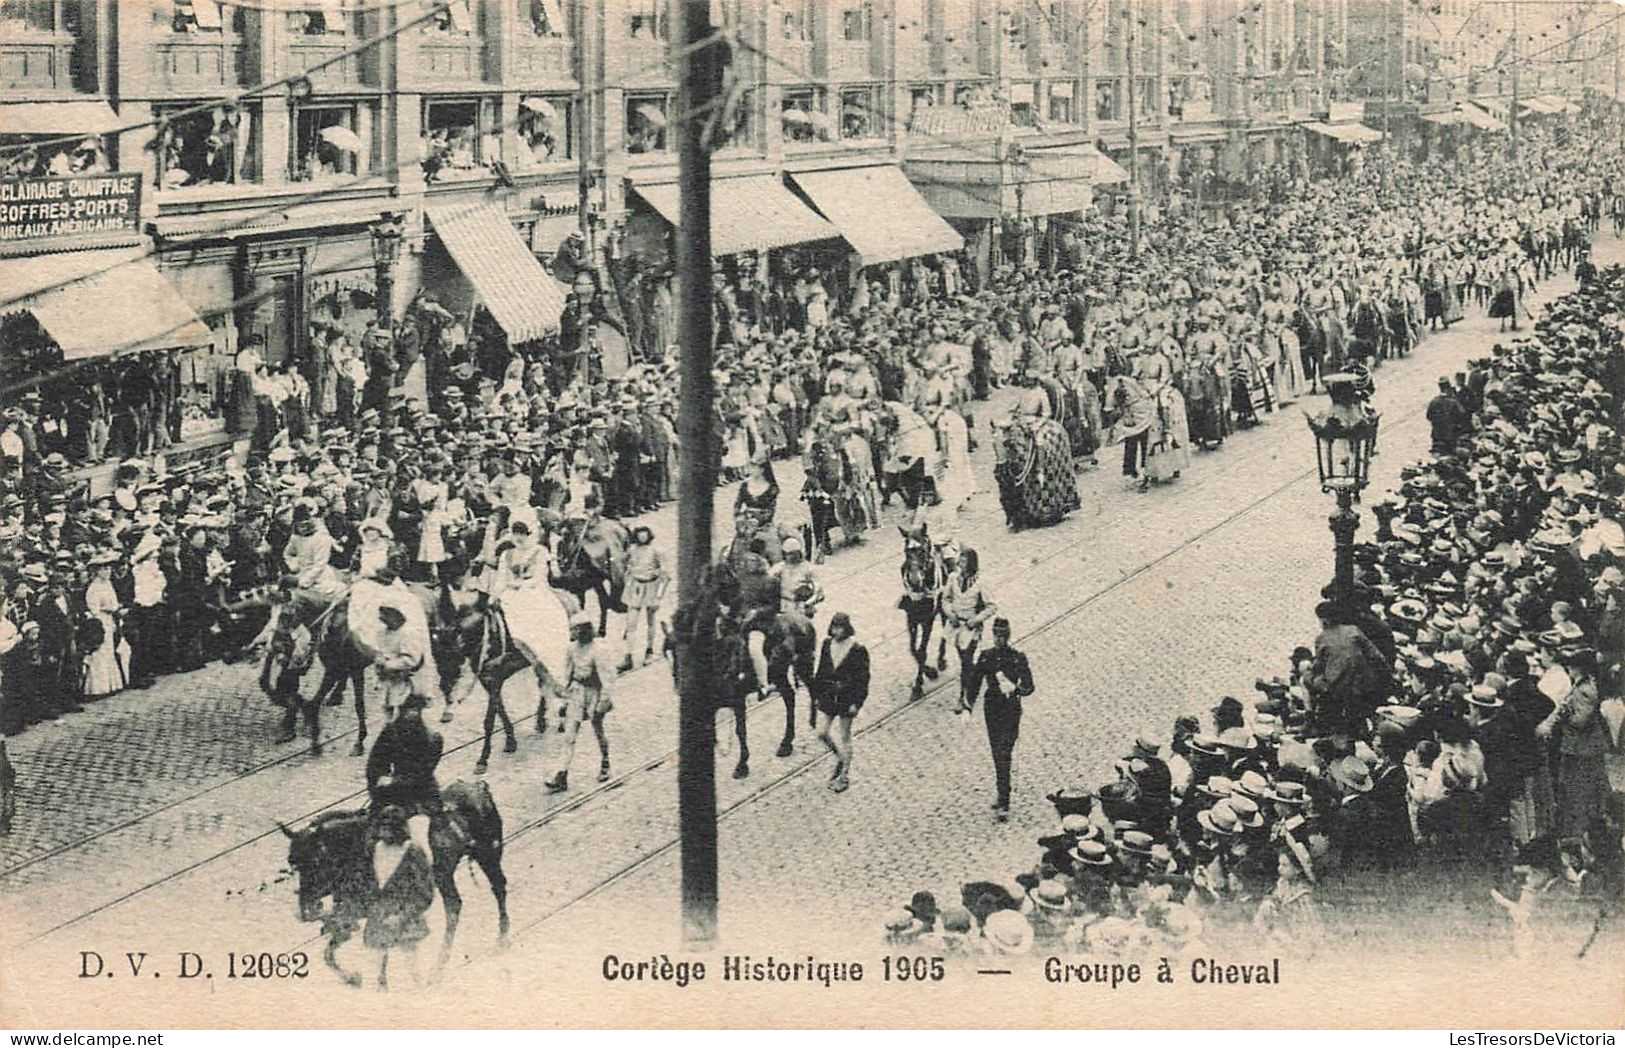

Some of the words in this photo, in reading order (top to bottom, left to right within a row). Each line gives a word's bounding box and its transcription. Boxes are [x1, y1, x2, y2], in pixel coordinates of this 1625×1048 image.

[0, 181, 64, 202] CLAIRAGE
[68, 177, 136, 198] CHAUFFAGE
[0, 198, 129, 222] COFFRES-PORTS
[0, 222, 48, 239] UREAUX
